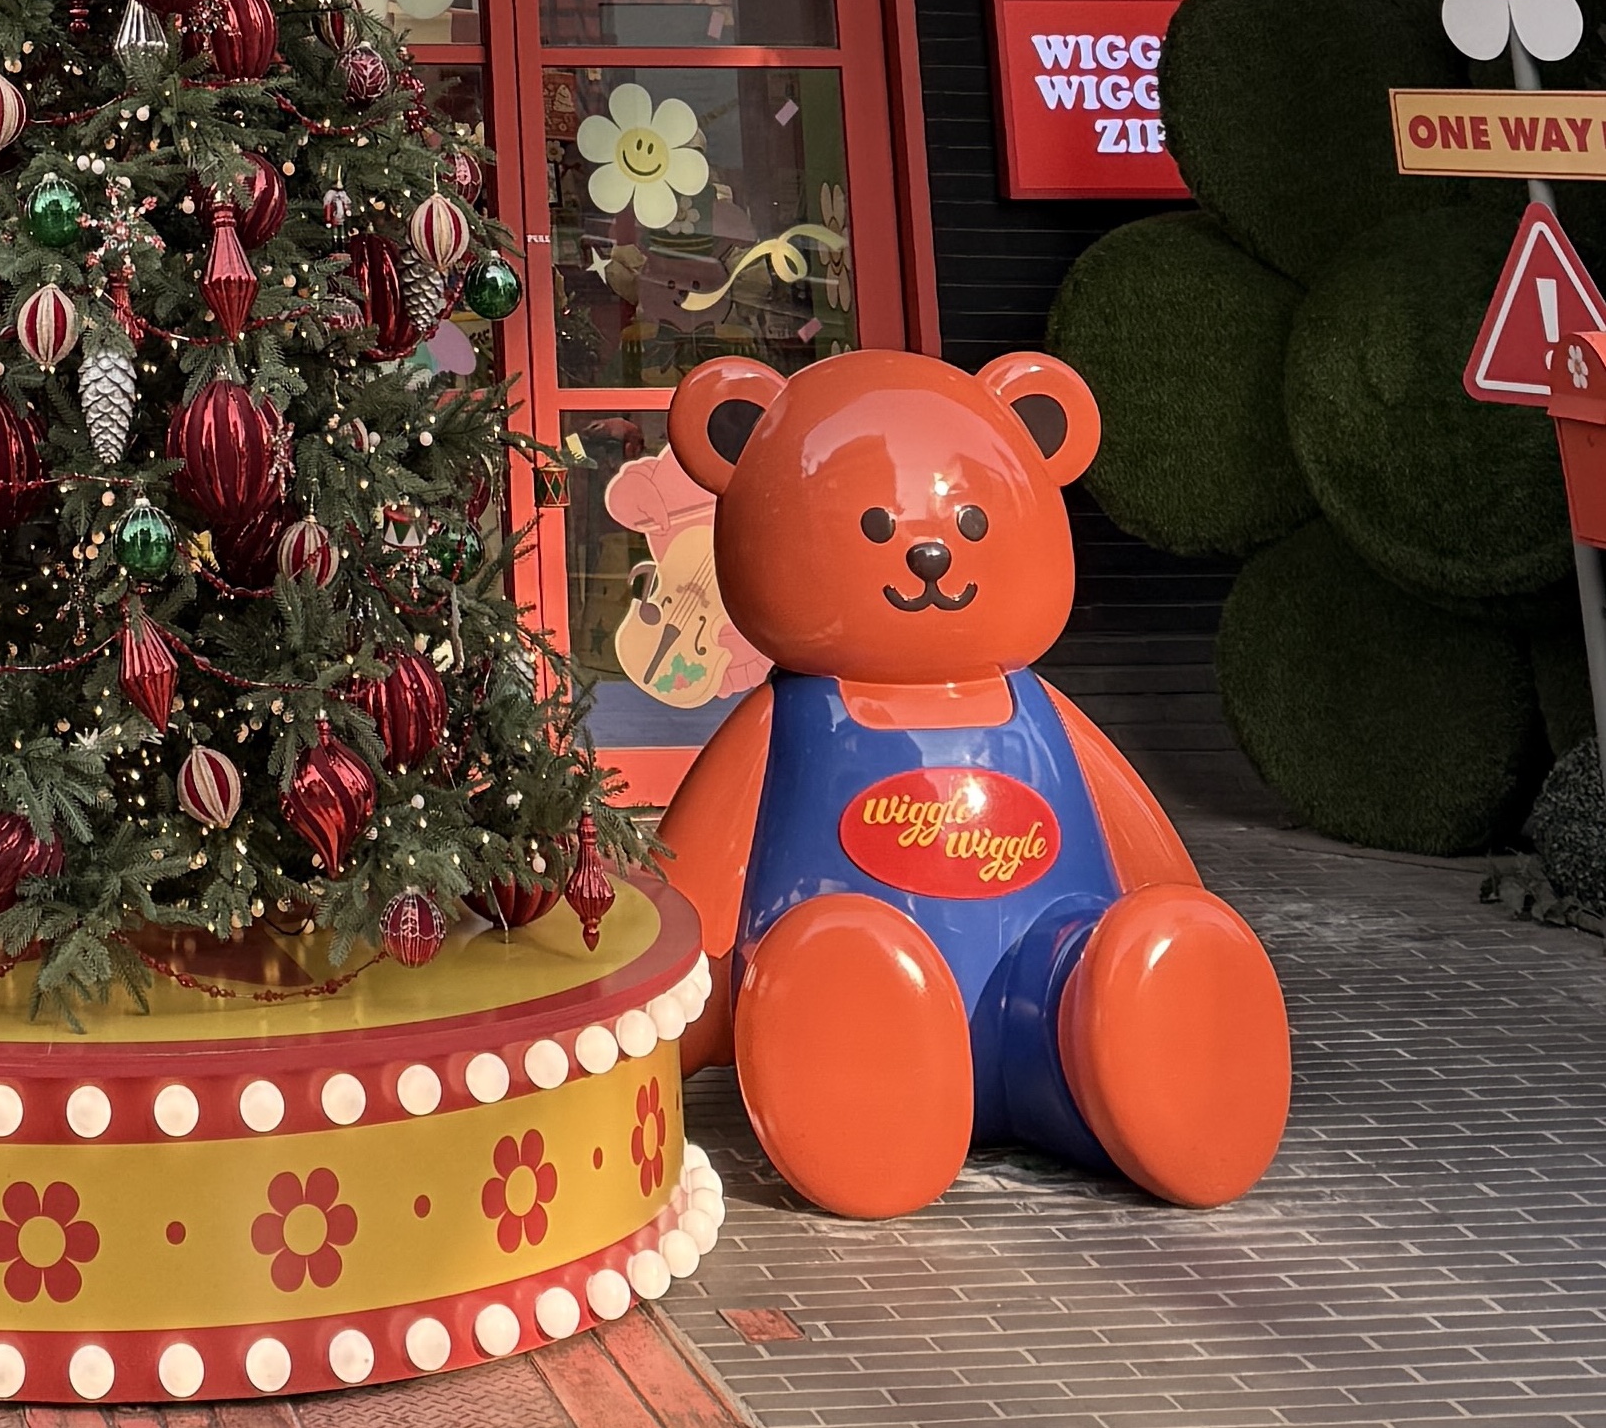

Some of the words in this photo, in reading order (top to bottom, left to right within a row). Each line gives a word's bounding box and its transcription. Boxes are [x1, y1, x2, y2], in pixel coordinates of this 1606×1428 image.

[1030, 34, 1167, 70] WIGG
[1408, 114, 1492, 150] ONE
[1498, 116, 1593, 152] WAY
[862, 786, 977, 848] Wiggle
[945, 821, 1048, 883] Wiggle
